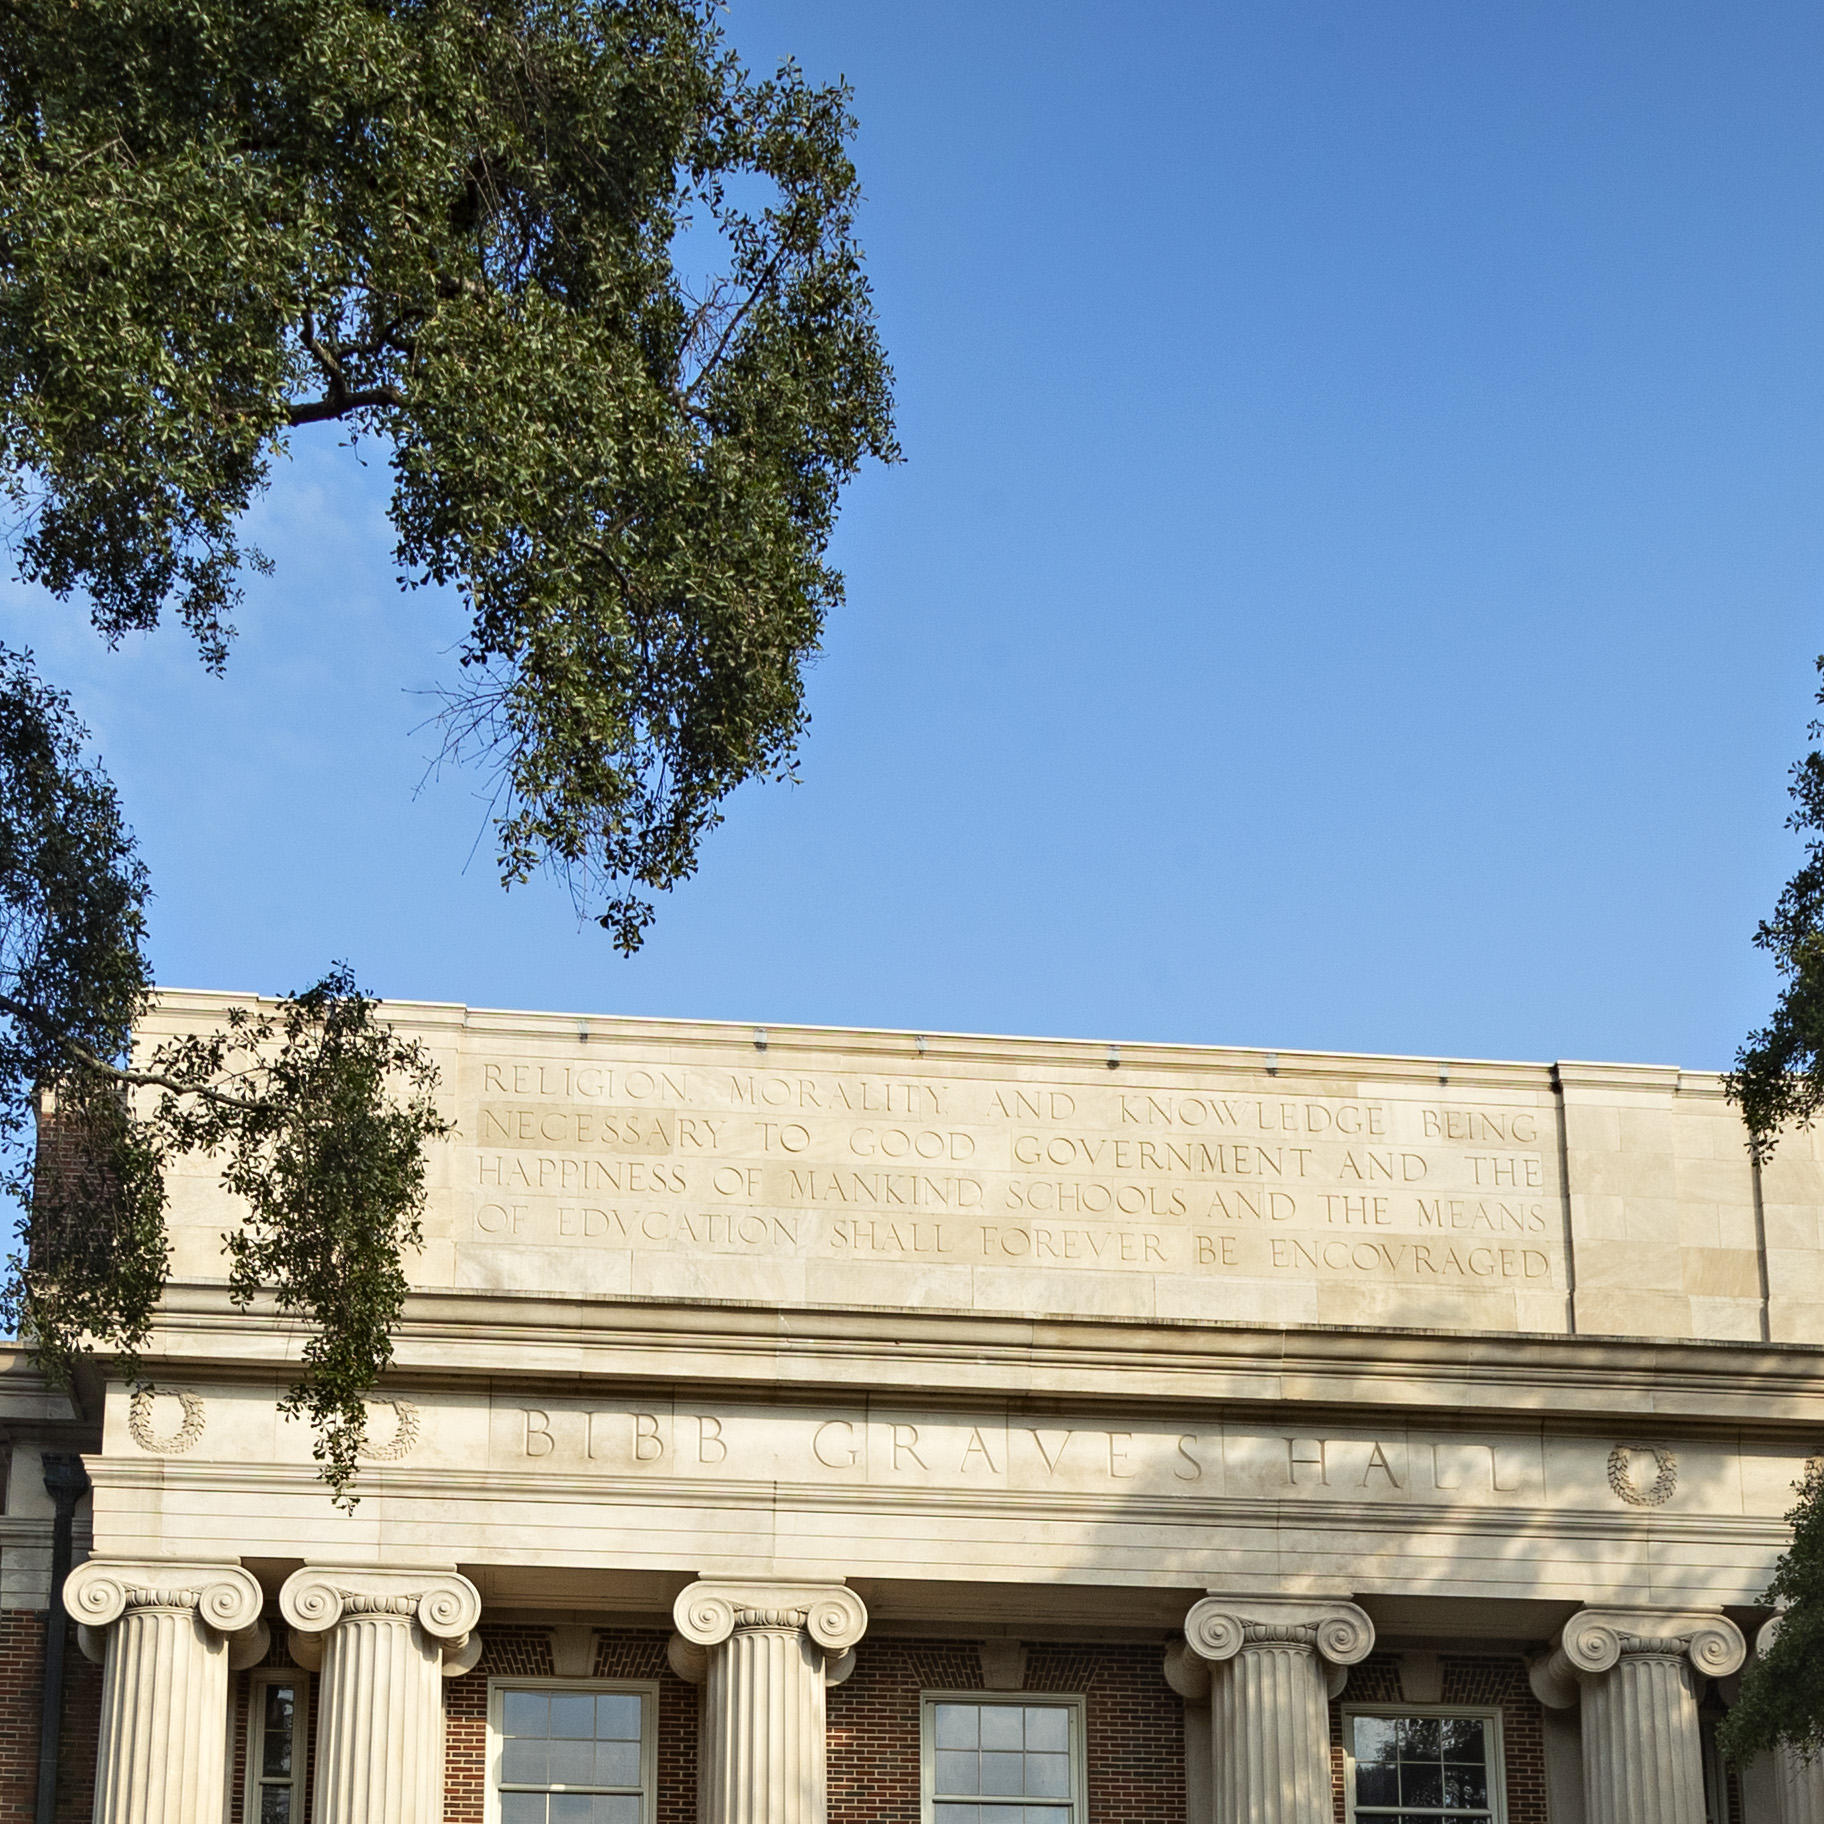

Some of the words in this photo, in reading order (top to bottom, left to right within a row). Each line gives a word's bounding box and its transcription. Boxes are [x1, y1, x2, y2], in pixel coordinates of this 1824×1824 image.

[484, 1109, 727, 1149] NECESSARY
[754, 1122, 811, 1152] TO
[848, 1127, 976, 1160] GOOD
[1014, 1135, 1313, 1178] GOVERNMENT
[1339, 1150, 1428, 1182] AND
[1465, 1156, 1543, 1188] THE
[986, 1089, 1076, 1121] AND
[1119, 1094, 1386, 1136] KNOWLEDGE
[1422, 1109, 1538, 1142] BEING
[477, 1155, 686, 1194] HAPPINESS
[712, 1166, 762, 1197] OF
[1005, 1180, 1186, 1217] SCHOOLS
[1207, 1190, 1296, 1222] AND
[1317, 1195, 1392, 1226] THE
[1416, 1198, 1546, 1233] MEANS
[477, 1203, 528, 1234] OF
[558, 1207, 800, 1247] EDVCATION
[831, 1219, 952, 1254] SHALL
[980, 1225, 1168, 1263] FOREVER
[1196, 1235, 1237, 1266] BE
[1270, 1238, 1549, 1279] ENCOVRAGED
[520, 1408, 728, 1465] BIBB
[811, 1419, 1203, 1482] GRAVES
[1281, 1436, 1519, 1493] HALL
